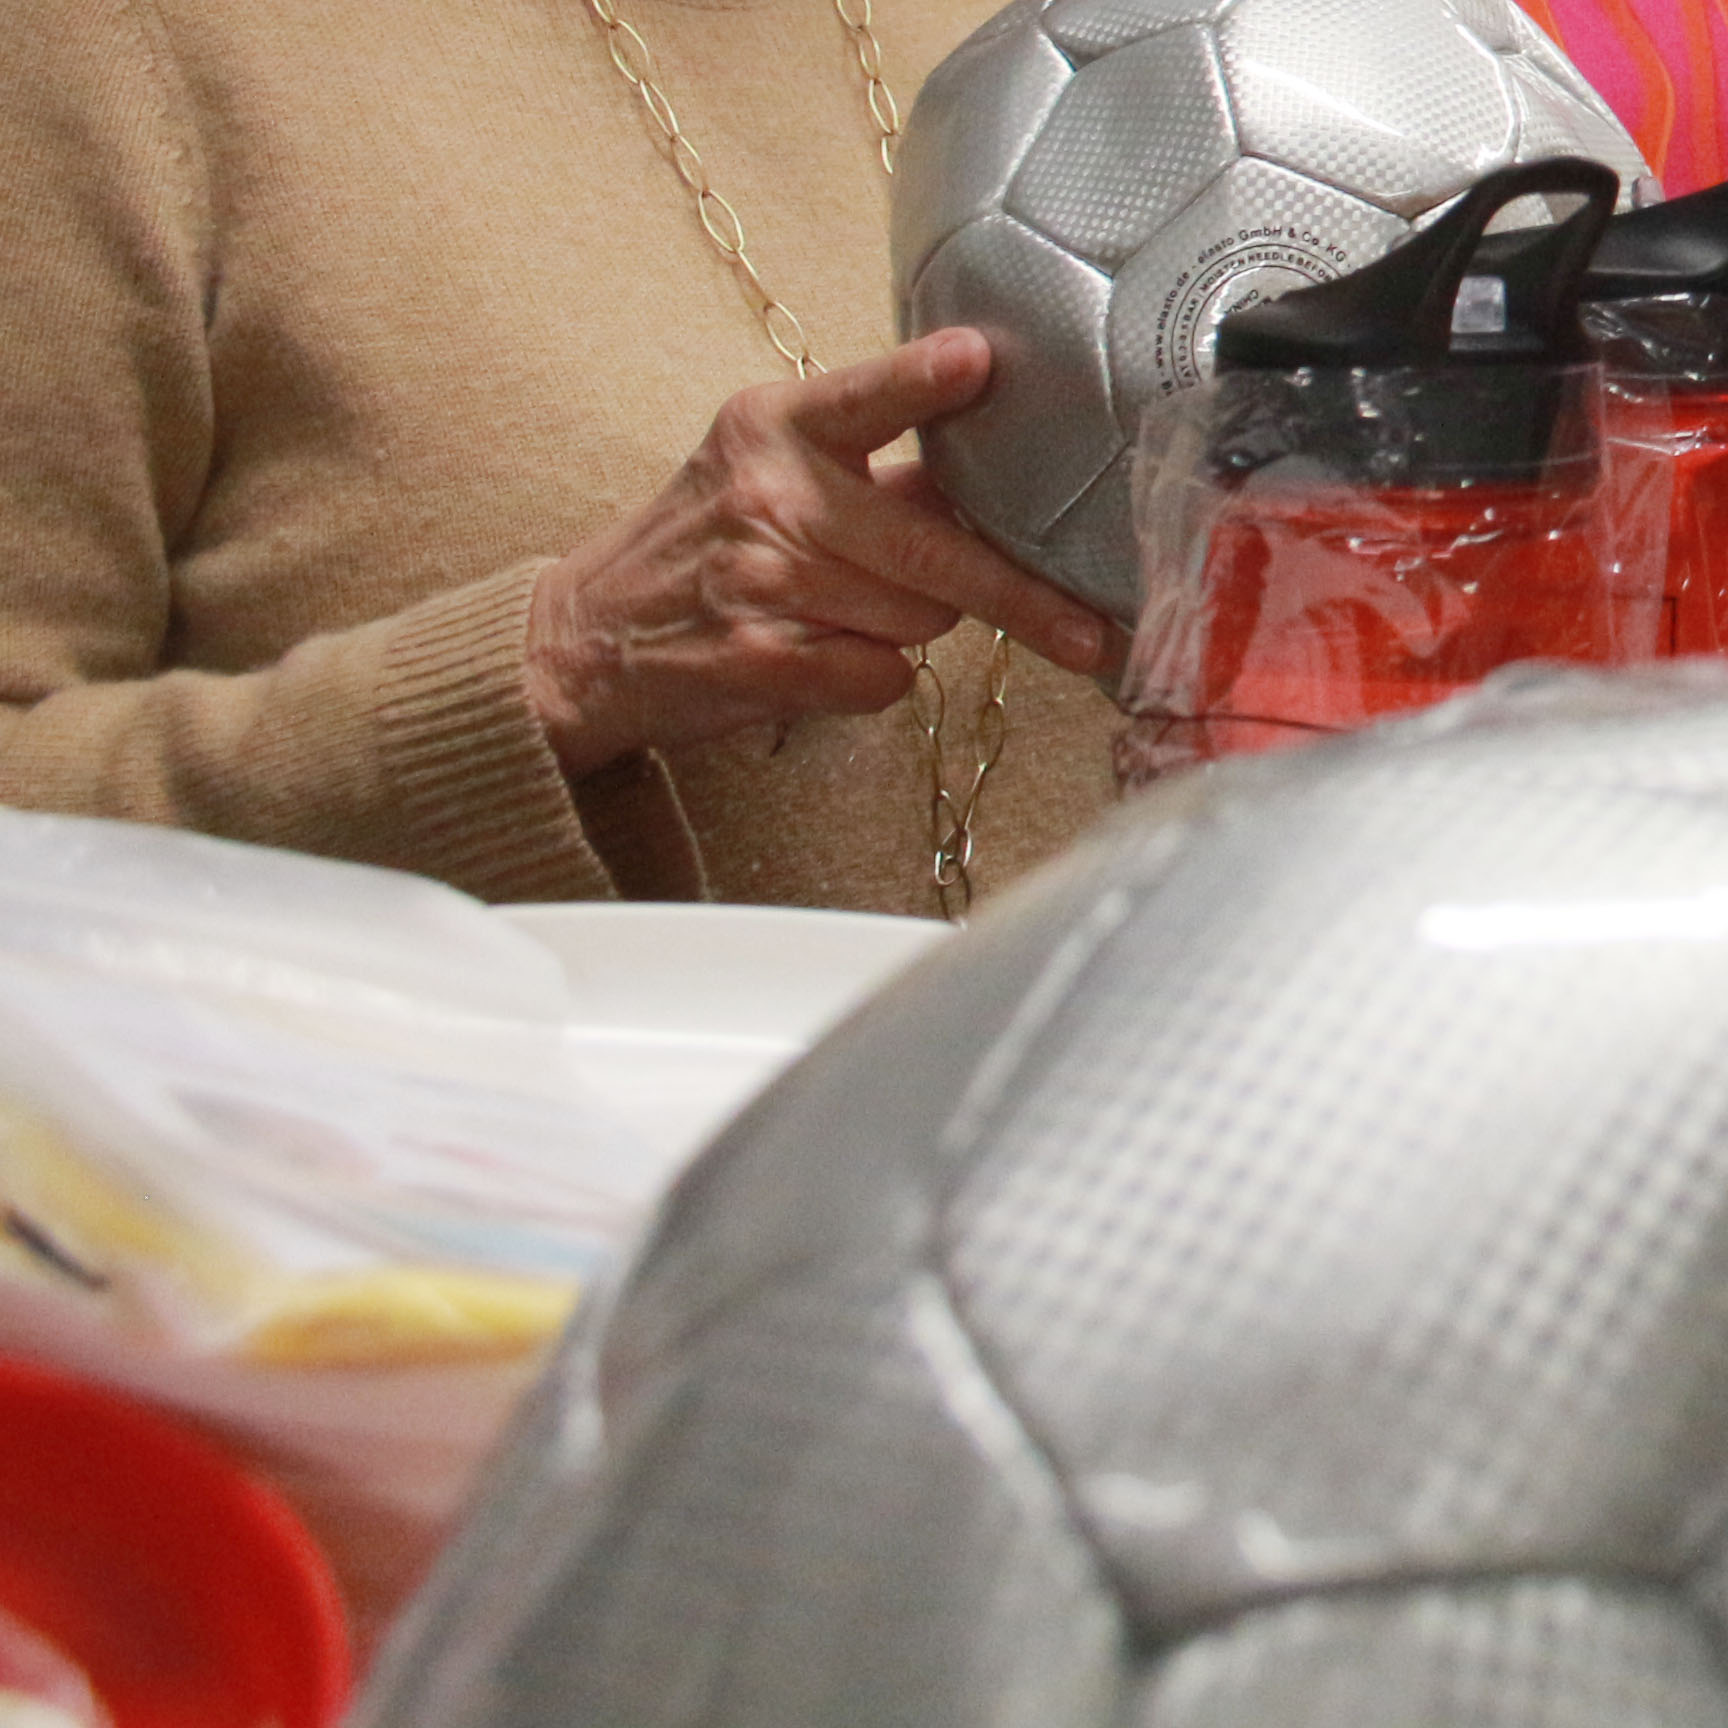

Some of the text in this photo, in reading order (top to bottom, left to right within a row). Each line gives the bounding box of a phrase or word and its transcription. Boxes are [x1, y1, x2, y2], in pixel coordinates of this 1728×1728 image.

[1238, 225, 1283, 241] GmbH
[1288, 227, 1297, 239] &
[1325, 243, 1347, 263] KG
[1248, 251, 1295, 263] NEEDLE
